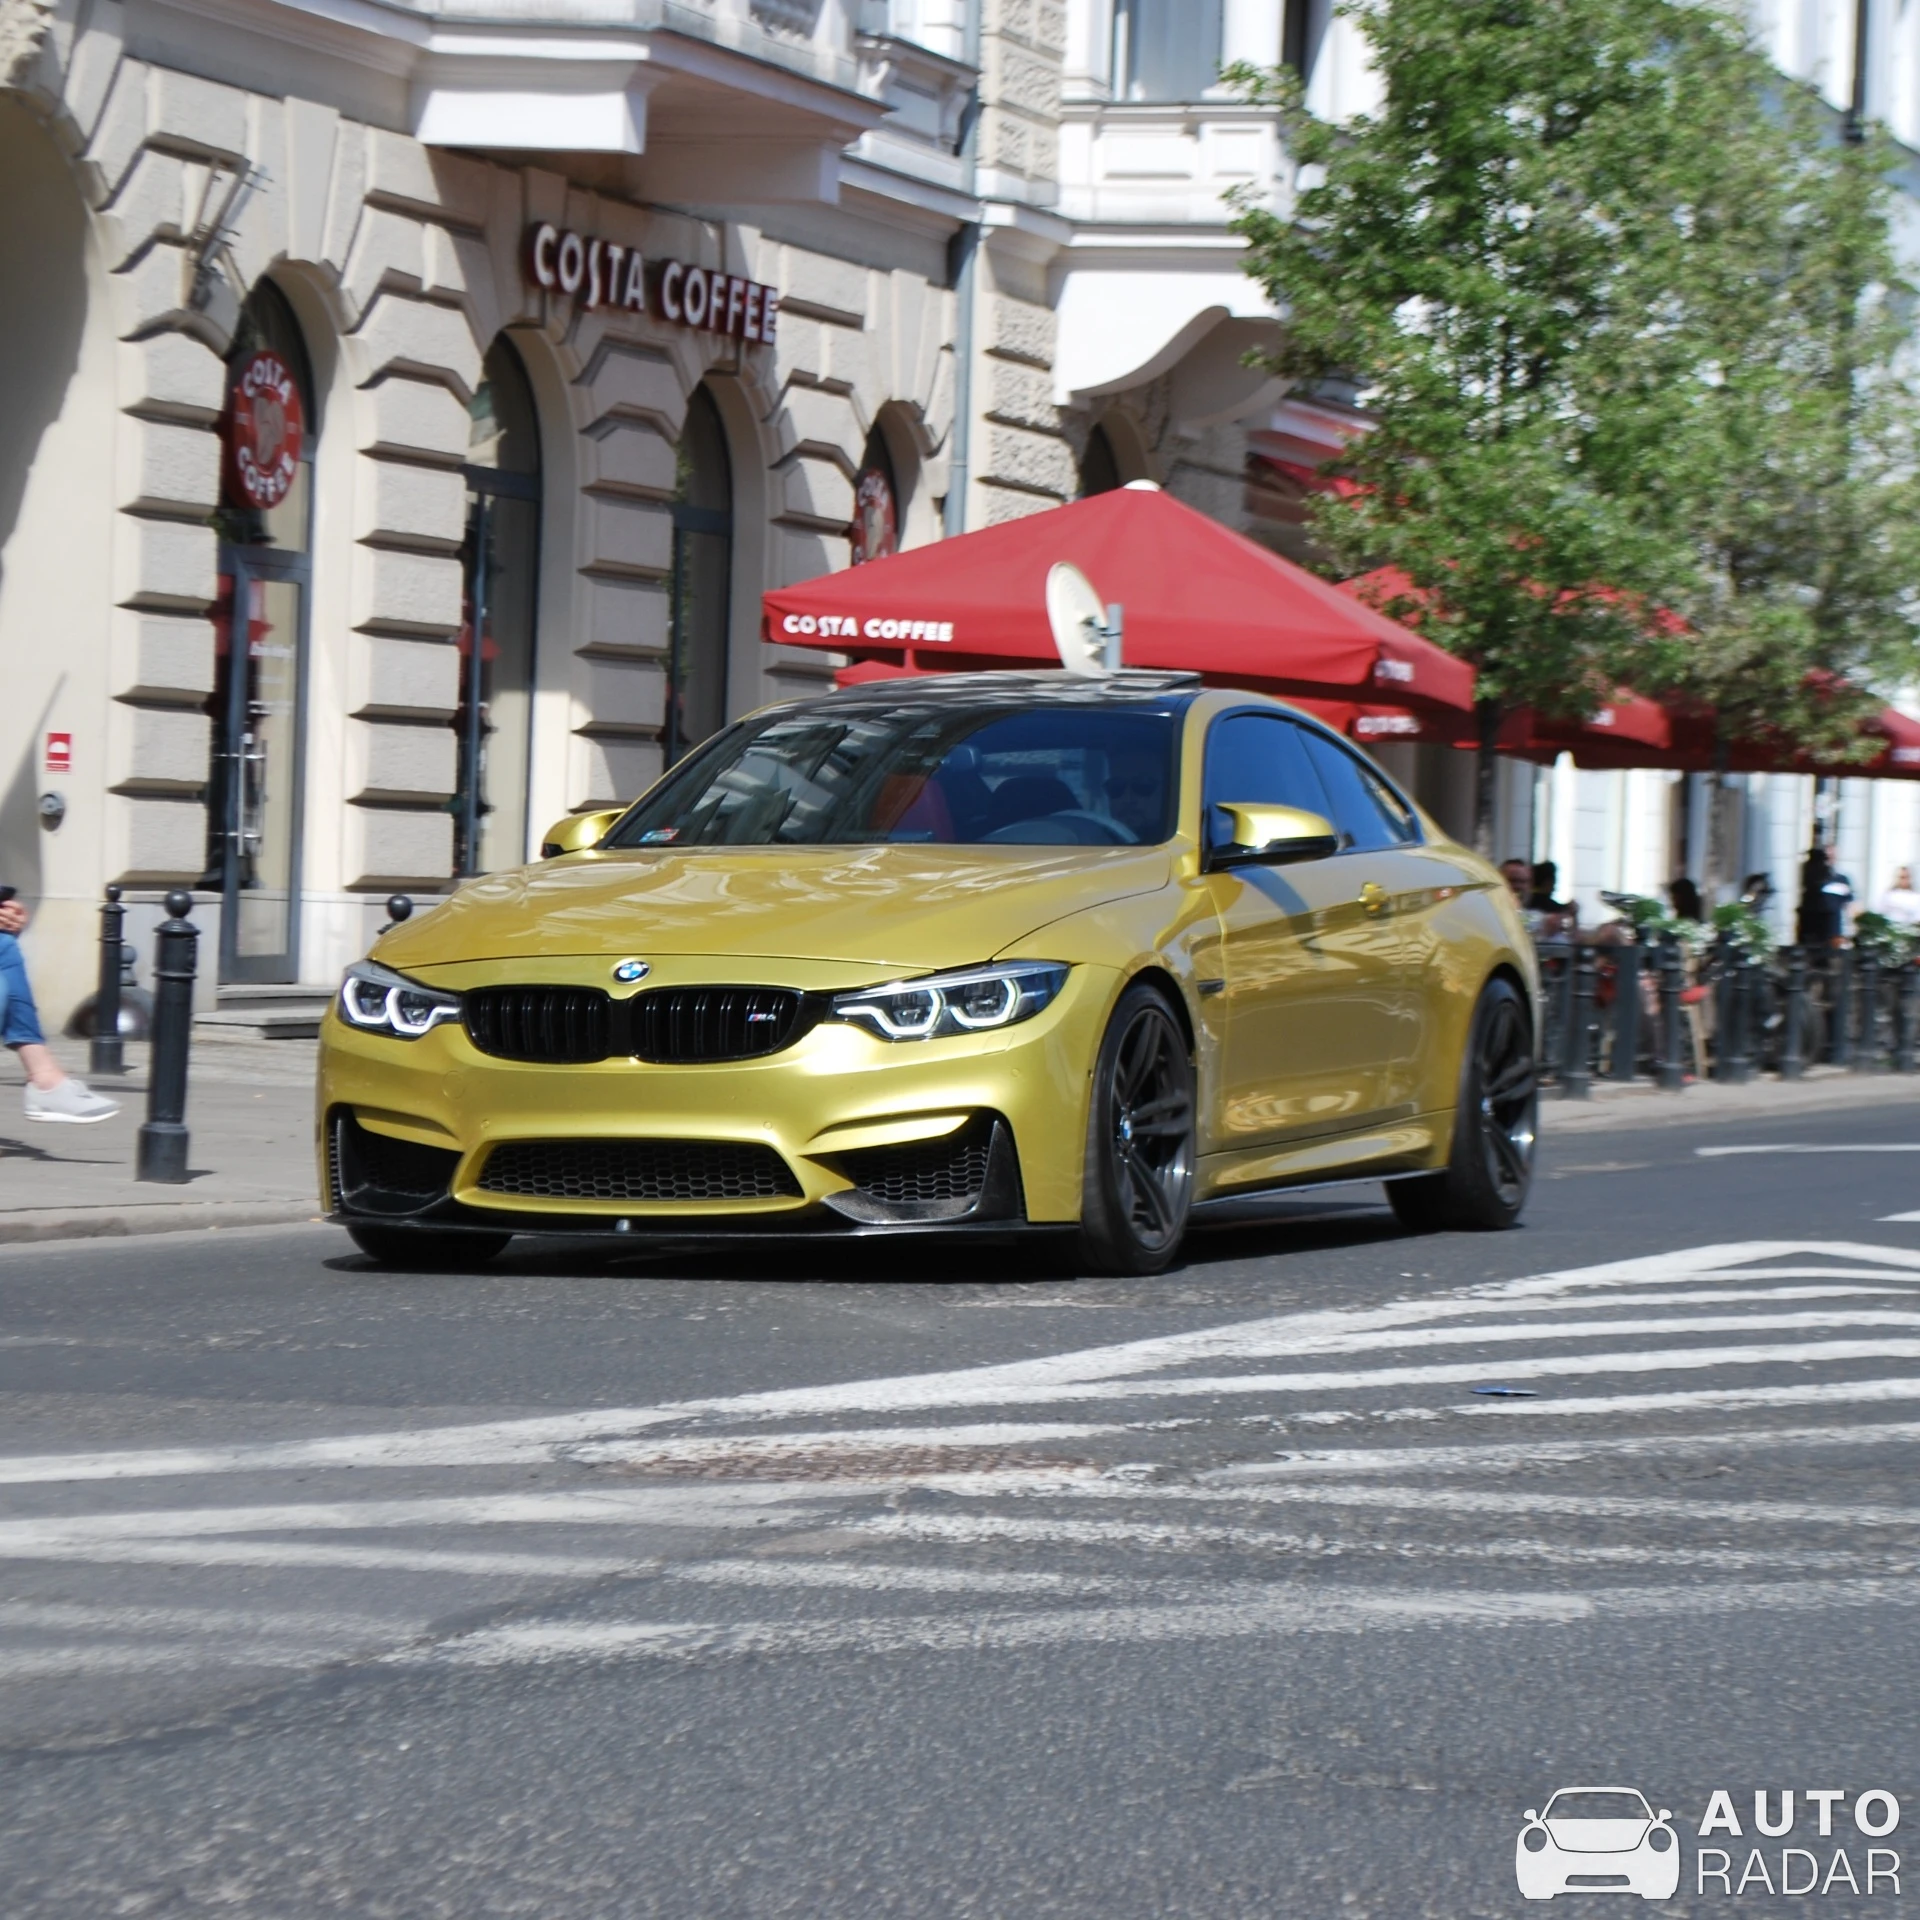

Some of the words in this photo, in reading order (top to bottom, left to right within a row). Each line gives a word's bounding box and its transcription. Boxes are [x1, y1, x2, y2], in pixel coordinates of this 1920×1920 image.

[533, 223, 645, 312] COSTA
[662, 261, 777, 344] COFFEE
[242, 358, 293, 406] COSTA
[238, 446, 294, 503] COFFEE
[783, 613, 858, 637] COSTA
[863, 617, 954, 642] COFFEE
